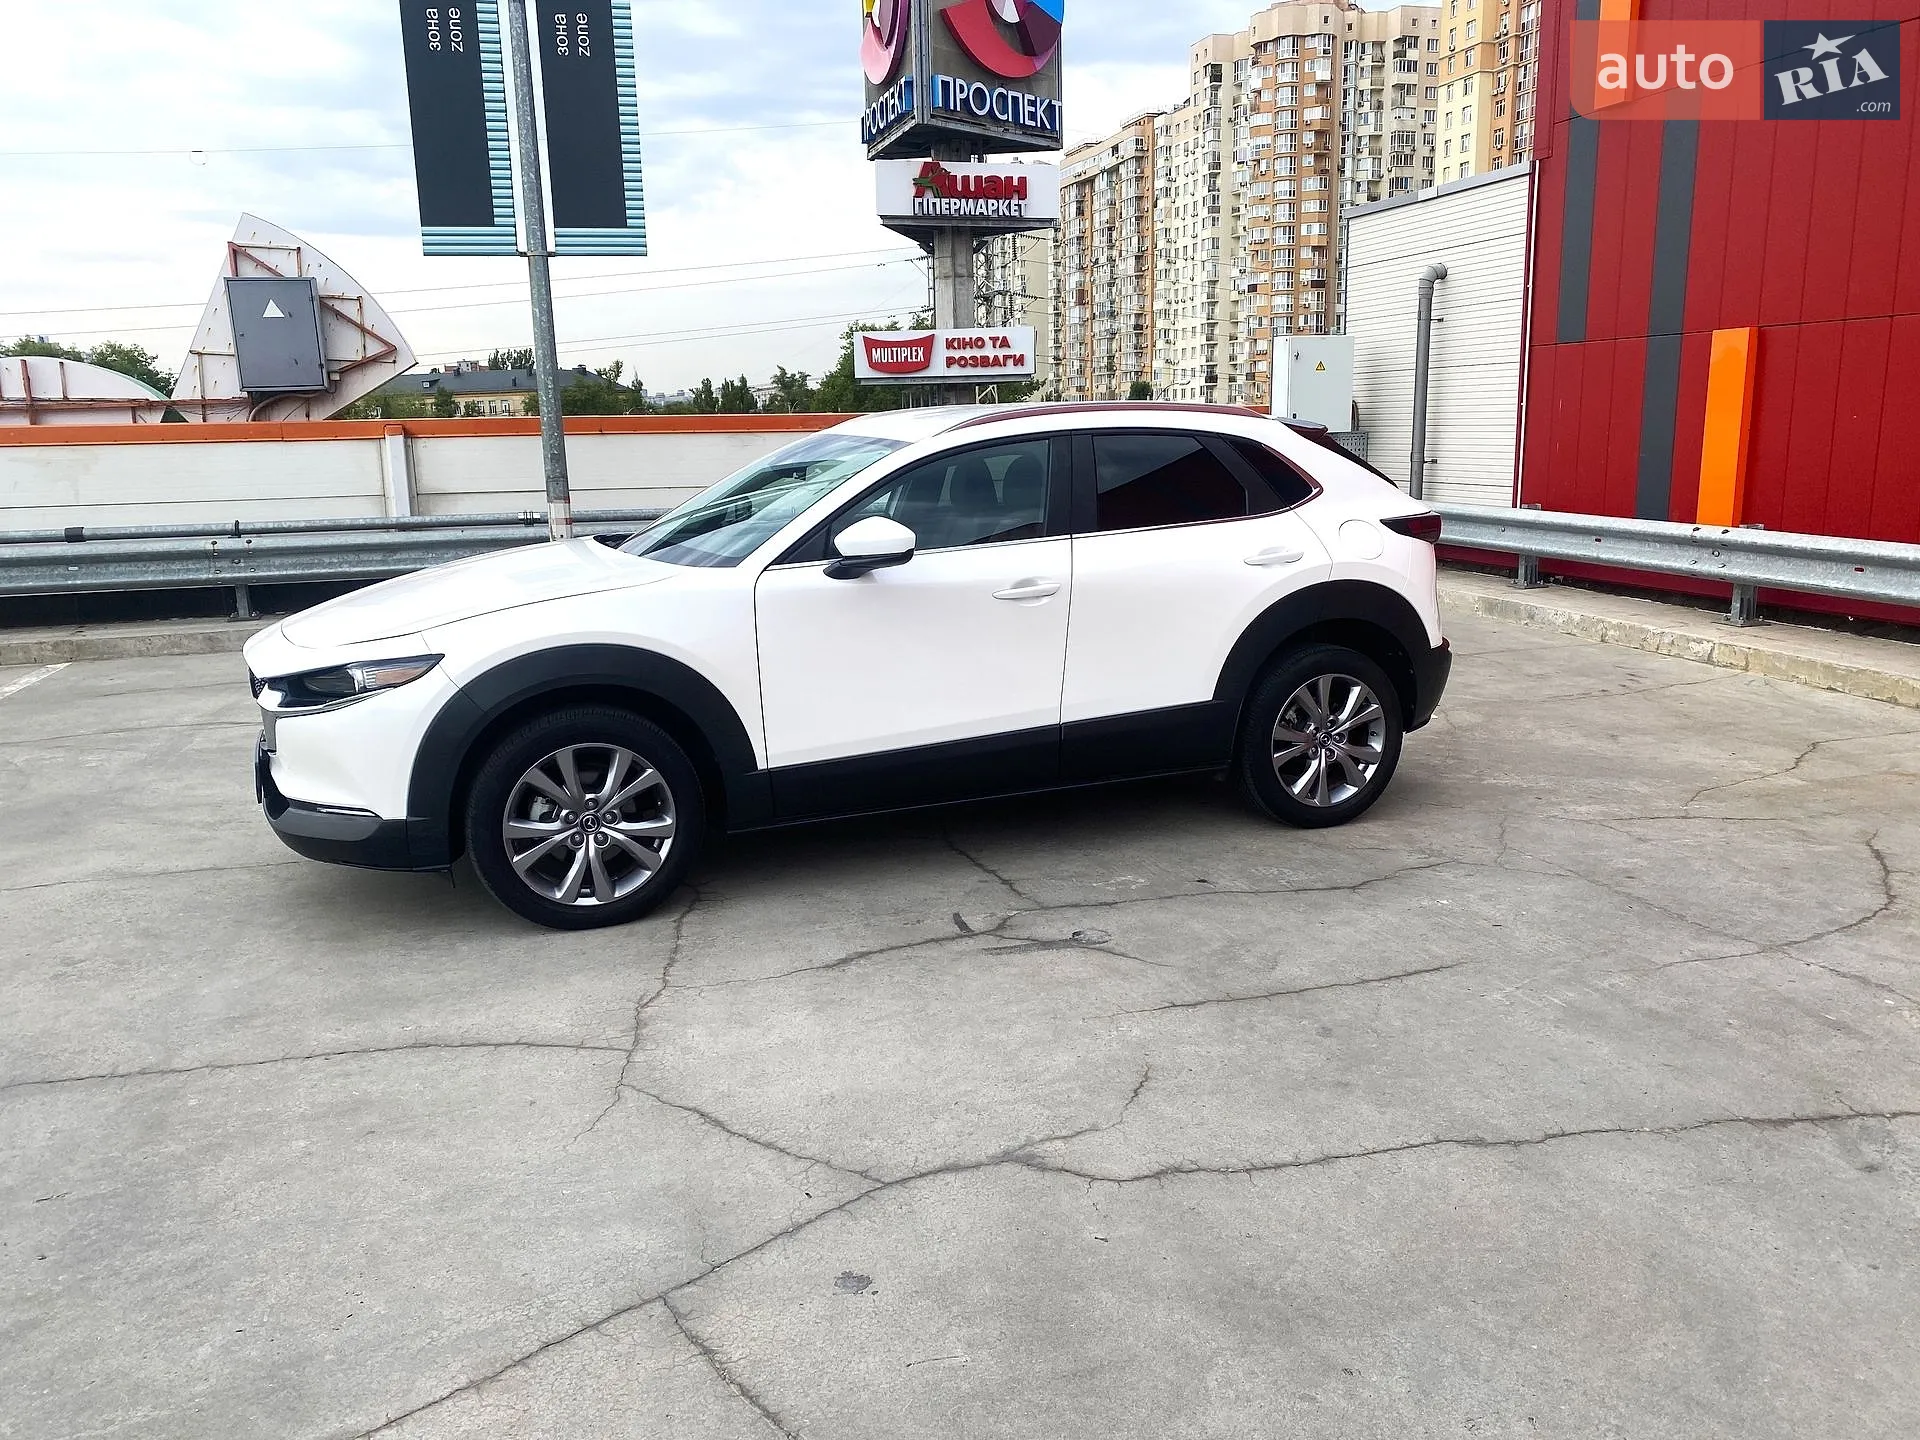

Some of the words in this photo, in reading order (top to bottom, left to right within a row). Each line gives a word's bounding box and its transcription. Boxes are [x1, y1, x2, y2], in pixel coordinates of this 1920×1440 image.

[425, 7, 441, 51] зона
[448, 6, 464, 53] zone
[555, 13, 569, 56] зона
[575, 12, 591, 57] zone
[937, 74, 1062, 139] ПРОСПЕКТ
[913, 161, 1027, 199] Ашан
[914, 198, 1026, 216] ГІПЕРМАРКЕТ
[871, 346, 924, 363] MULTIPLEX
[945, 336, 984, 350] КІНО
[988, 335, 1011, 349] ТА
[945, 353, 1025, 369] РОЗВАГИ
